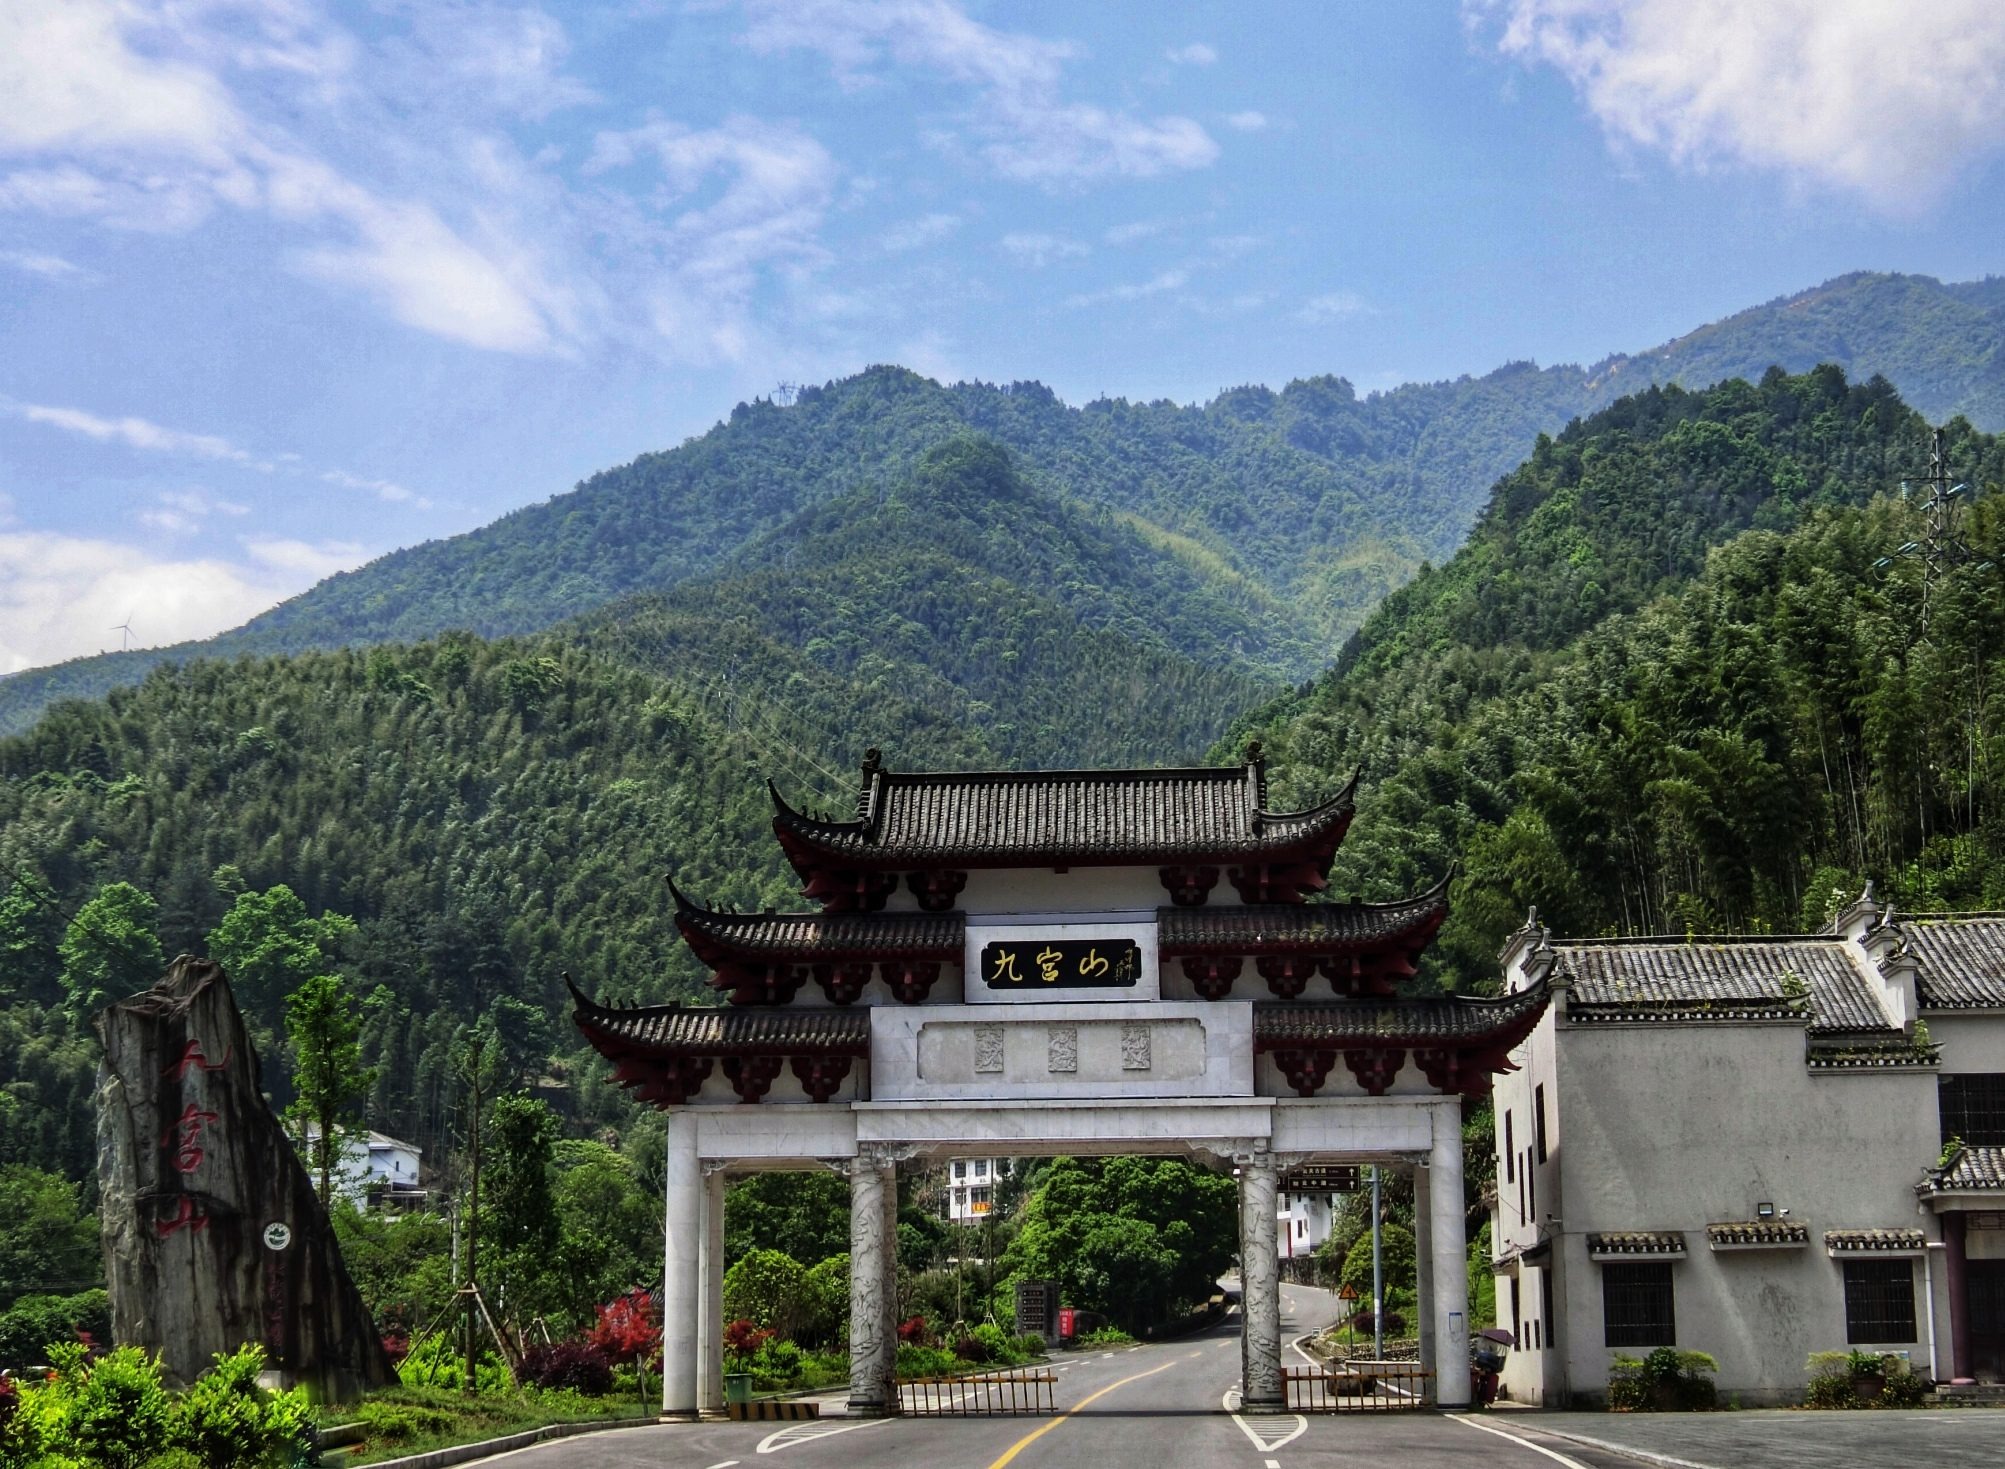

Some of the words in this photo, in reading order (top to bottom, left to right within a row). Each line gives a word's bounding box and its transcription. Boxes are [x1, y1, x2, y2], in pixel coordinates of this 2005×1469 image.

[991, 945, 1109, 982] 九宫山
[157, 1039, 232, 1239] 九宫山
